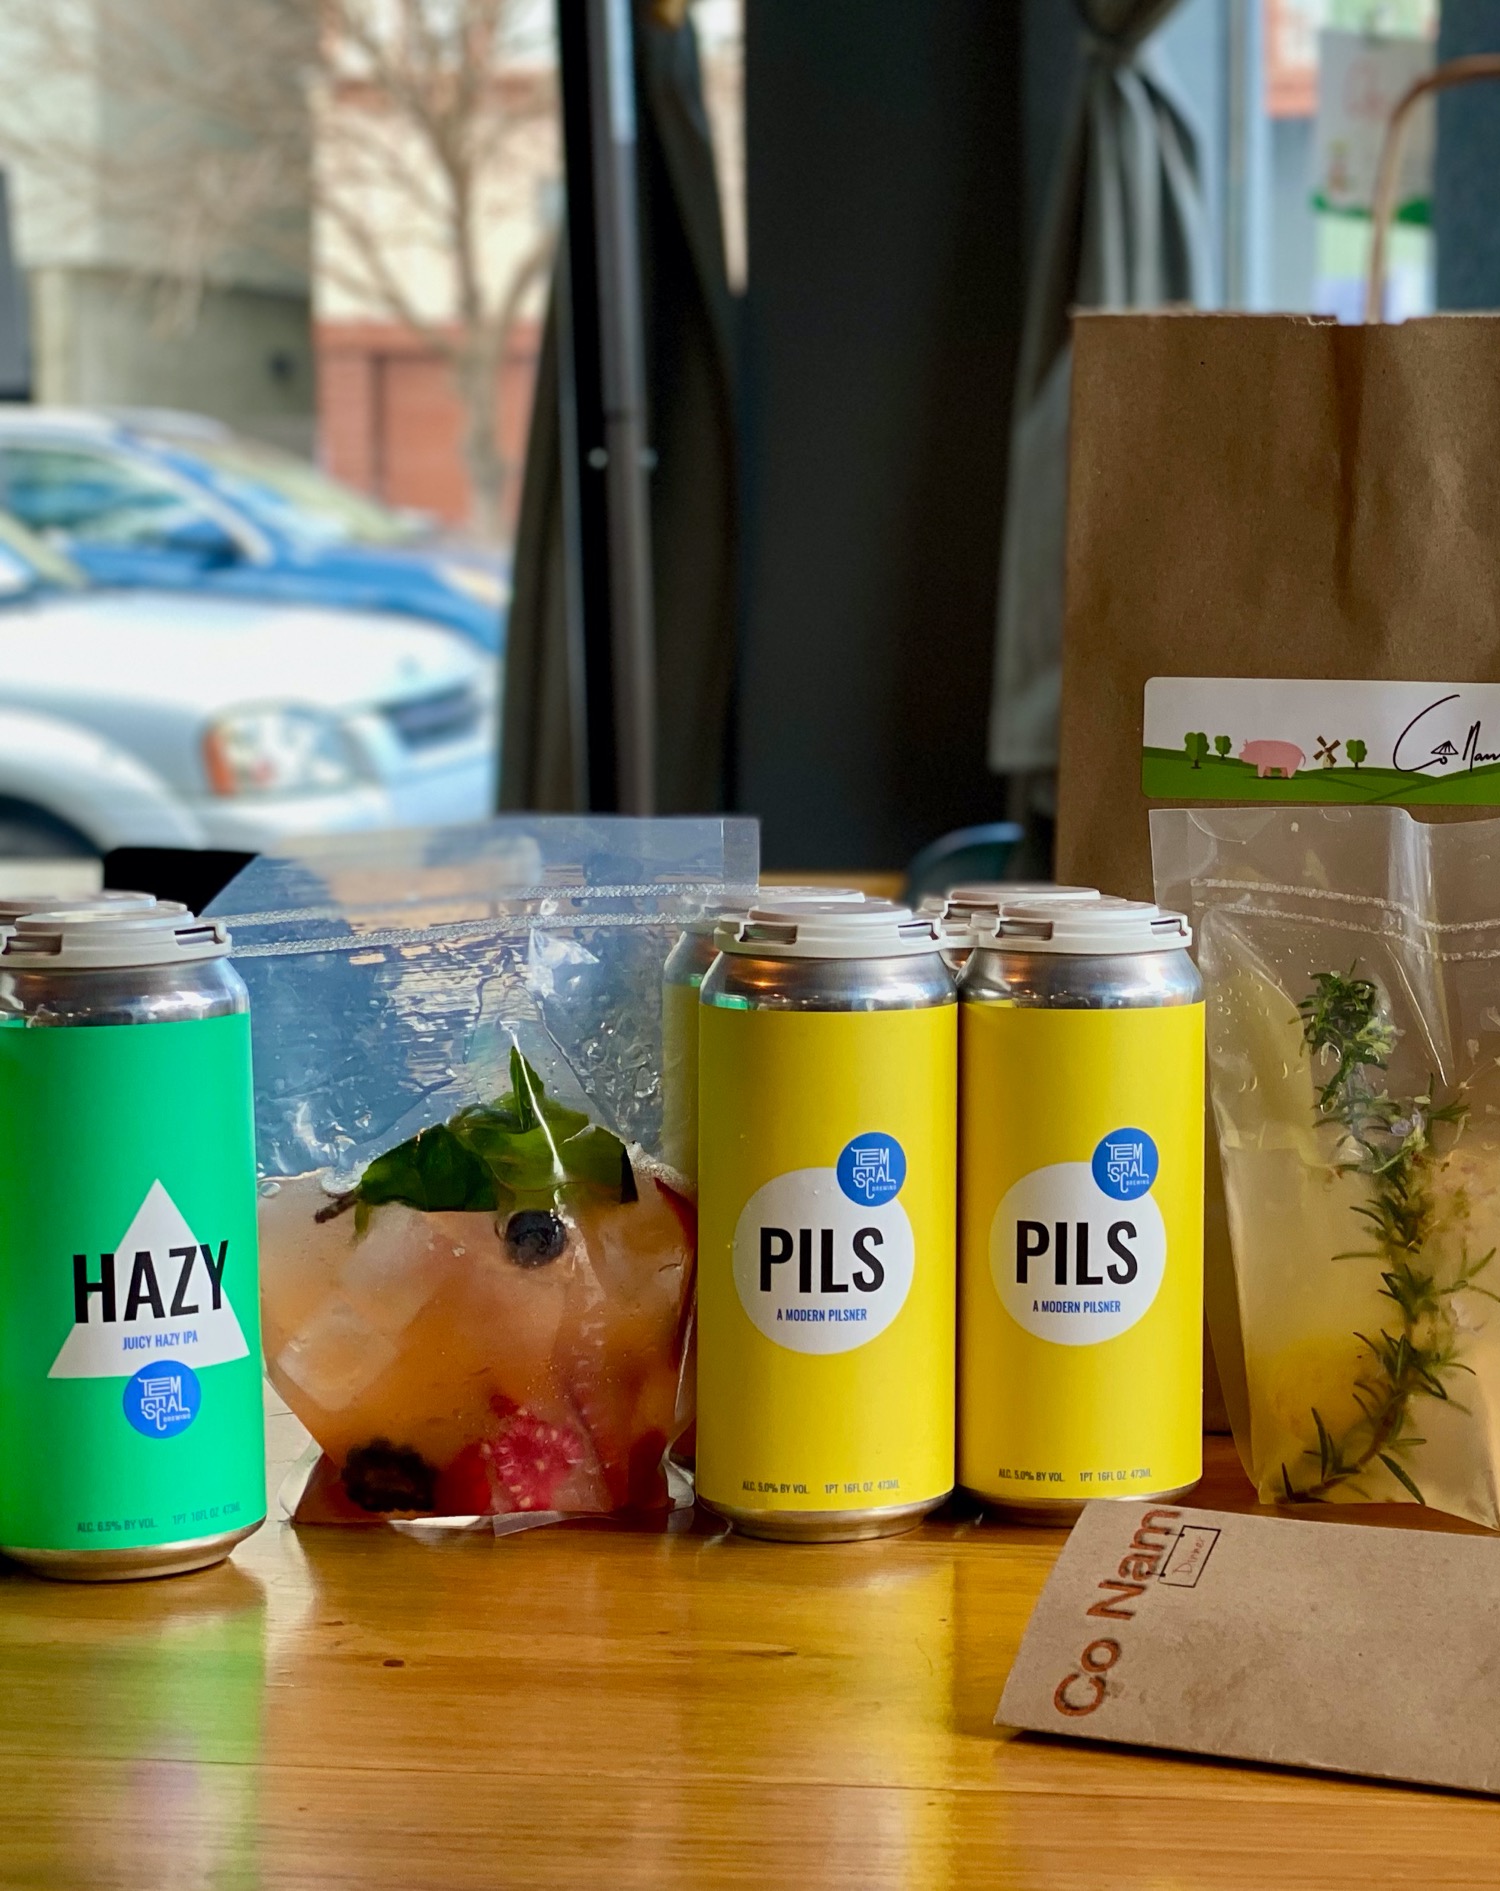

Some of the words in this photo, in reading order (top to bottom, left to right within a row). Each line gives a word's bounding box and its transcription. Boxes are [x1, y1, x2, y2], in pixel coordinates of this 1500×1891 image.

[760, 1226, 885, 1294] PILS
[1016, 1220, 1138, 1285] PILS
[73, 1239, 229, 1324] HAZY
[776, 1308, 783, 1321] A
[785, 1308, 825, 1322] MODERN
[828, 1308, 867, 1322] PILSNER
[1032, 1300, 1039, 1312] A
[1041, 1300, 1080, 1313] MODERN
[1083, 1300, 1121, 1313] PILSNER
[122, 1335, 152, 1350] JUICY
[155, 1332, 180, 1348] HAZY
[183, 1329, 198, 1345] IPA
[742, 1480, 756, 1491] ALC.
[758, 1482, 778, 1493] 5.0%
[780, 1483, 790, 1494] BY
[793, 1483, 810, 1494] VOL.
[825, 1484, 839, 1494] 1PT
[843, 1482, 861, 1493] 16FL
[863, 1481, 873, 1492] OZ
[877, 1479, 900, 1490] 473ML
[998, 1468, 1012, 1479] ALC.
[1014, 1470, 1035, 1481] 5.0%
[1036, 1471, 1046, 1481] BY
[1048, 1472, 1065, 1482] VOL.
[1080, 1472, 1093, 1482] 1PT
[1097, 1471, 1115, 1481] 16FL
[1116, 1470, 1127, 1481] OZ
[1130, 1468, 1152, 1479] 473ML
[124, 1519, 137, 1531] BY
[210, 1506, 220, 1519] OZ
[1085, 1509, 1182, 1621] Nam
[1172, 1537, 1206, 1576] Dinner
[1054, 1637, 1122, 1717] Co
